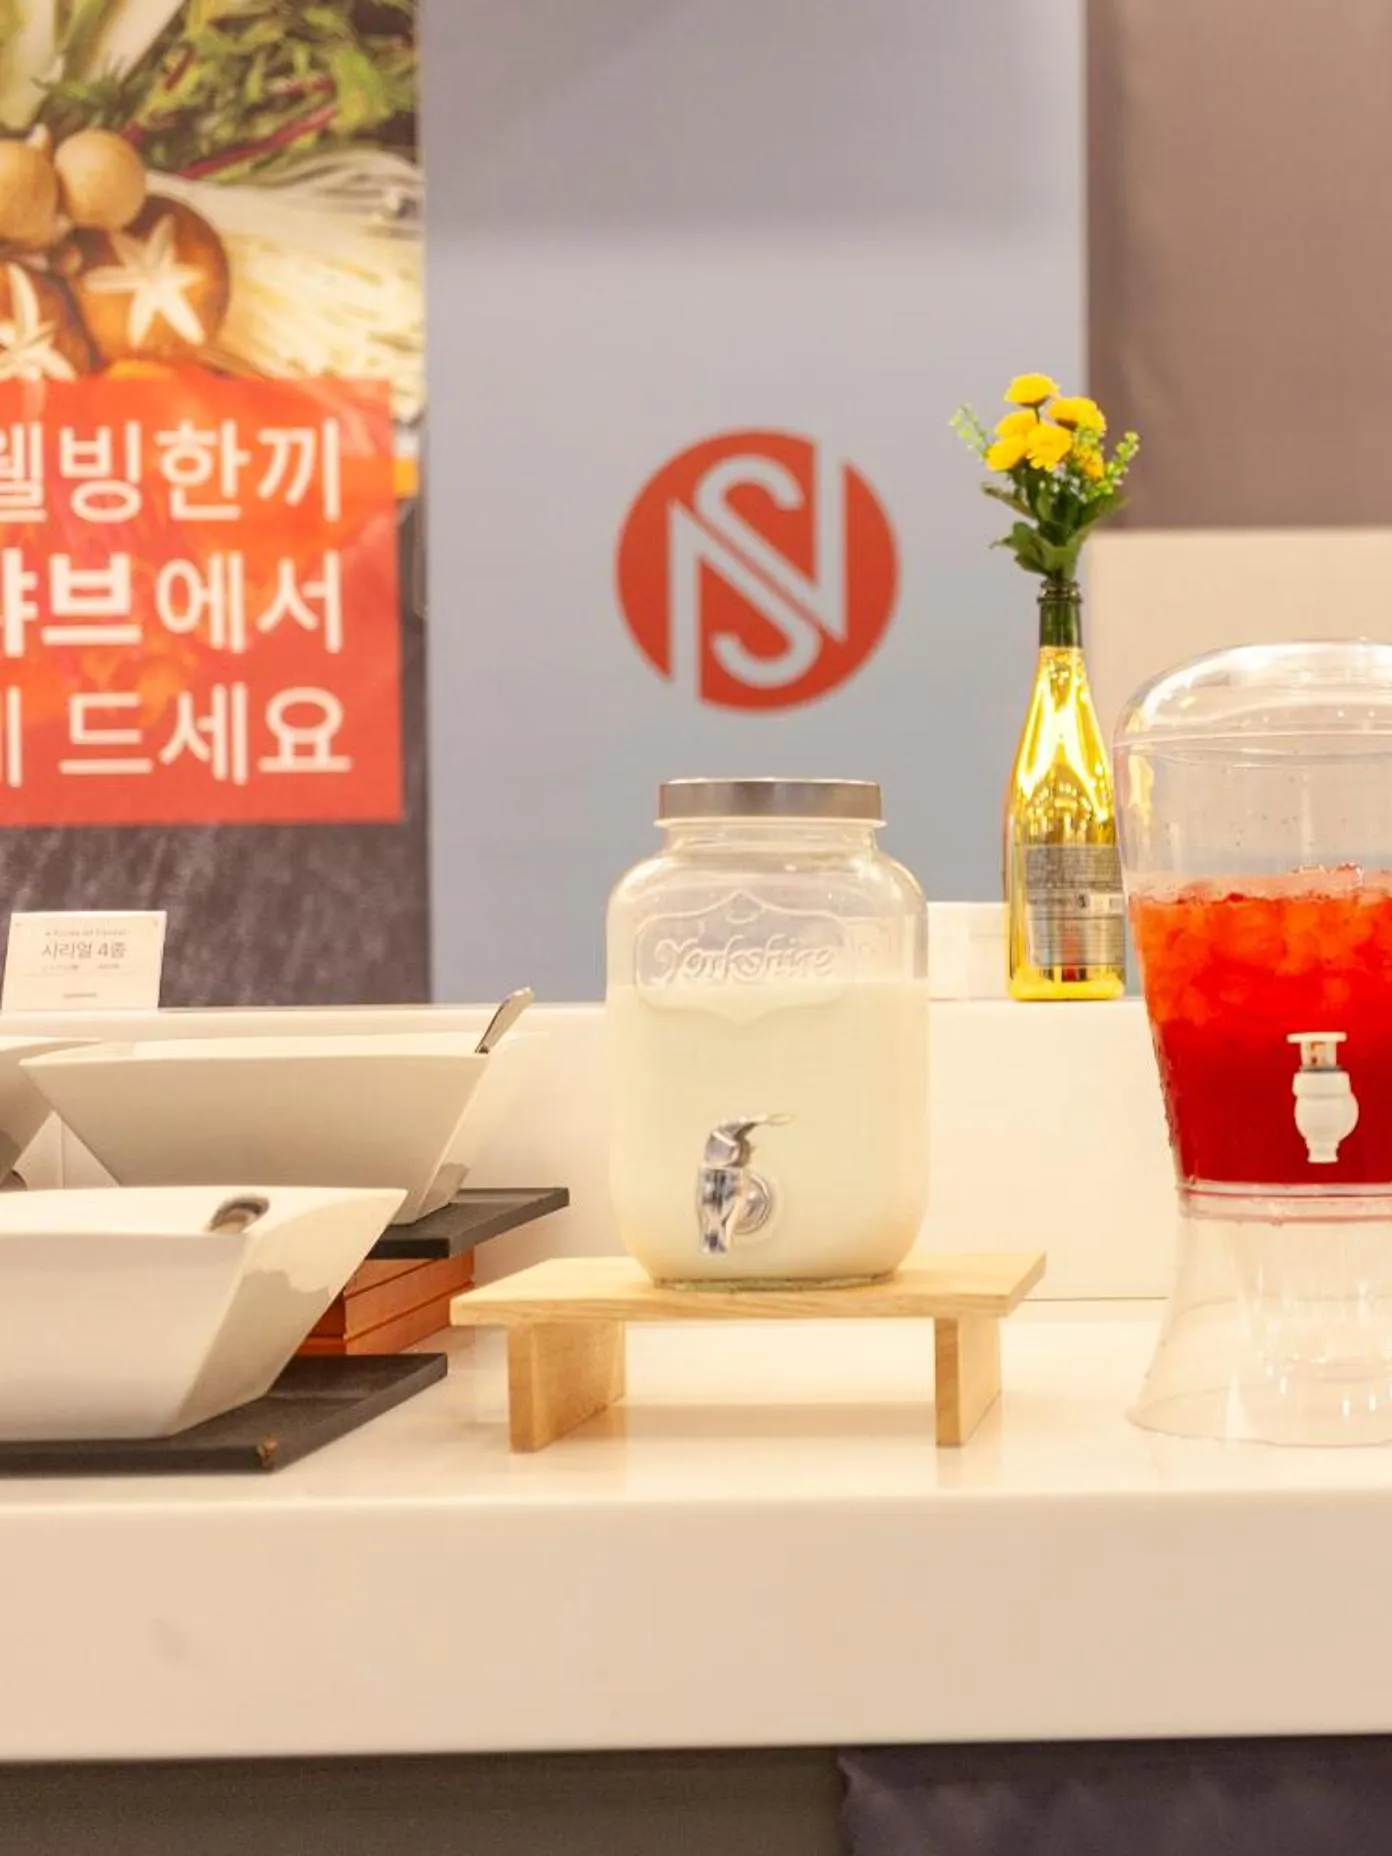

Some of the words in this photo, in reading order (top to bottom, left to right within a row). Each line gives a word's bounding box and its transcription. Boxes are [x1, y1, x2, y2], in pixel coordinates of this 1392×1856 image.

[58, 681, 353, 787] 드세요
[41, 941, 93, 959] 시리얼
[652, 933, 837, 986] Yorkshire
